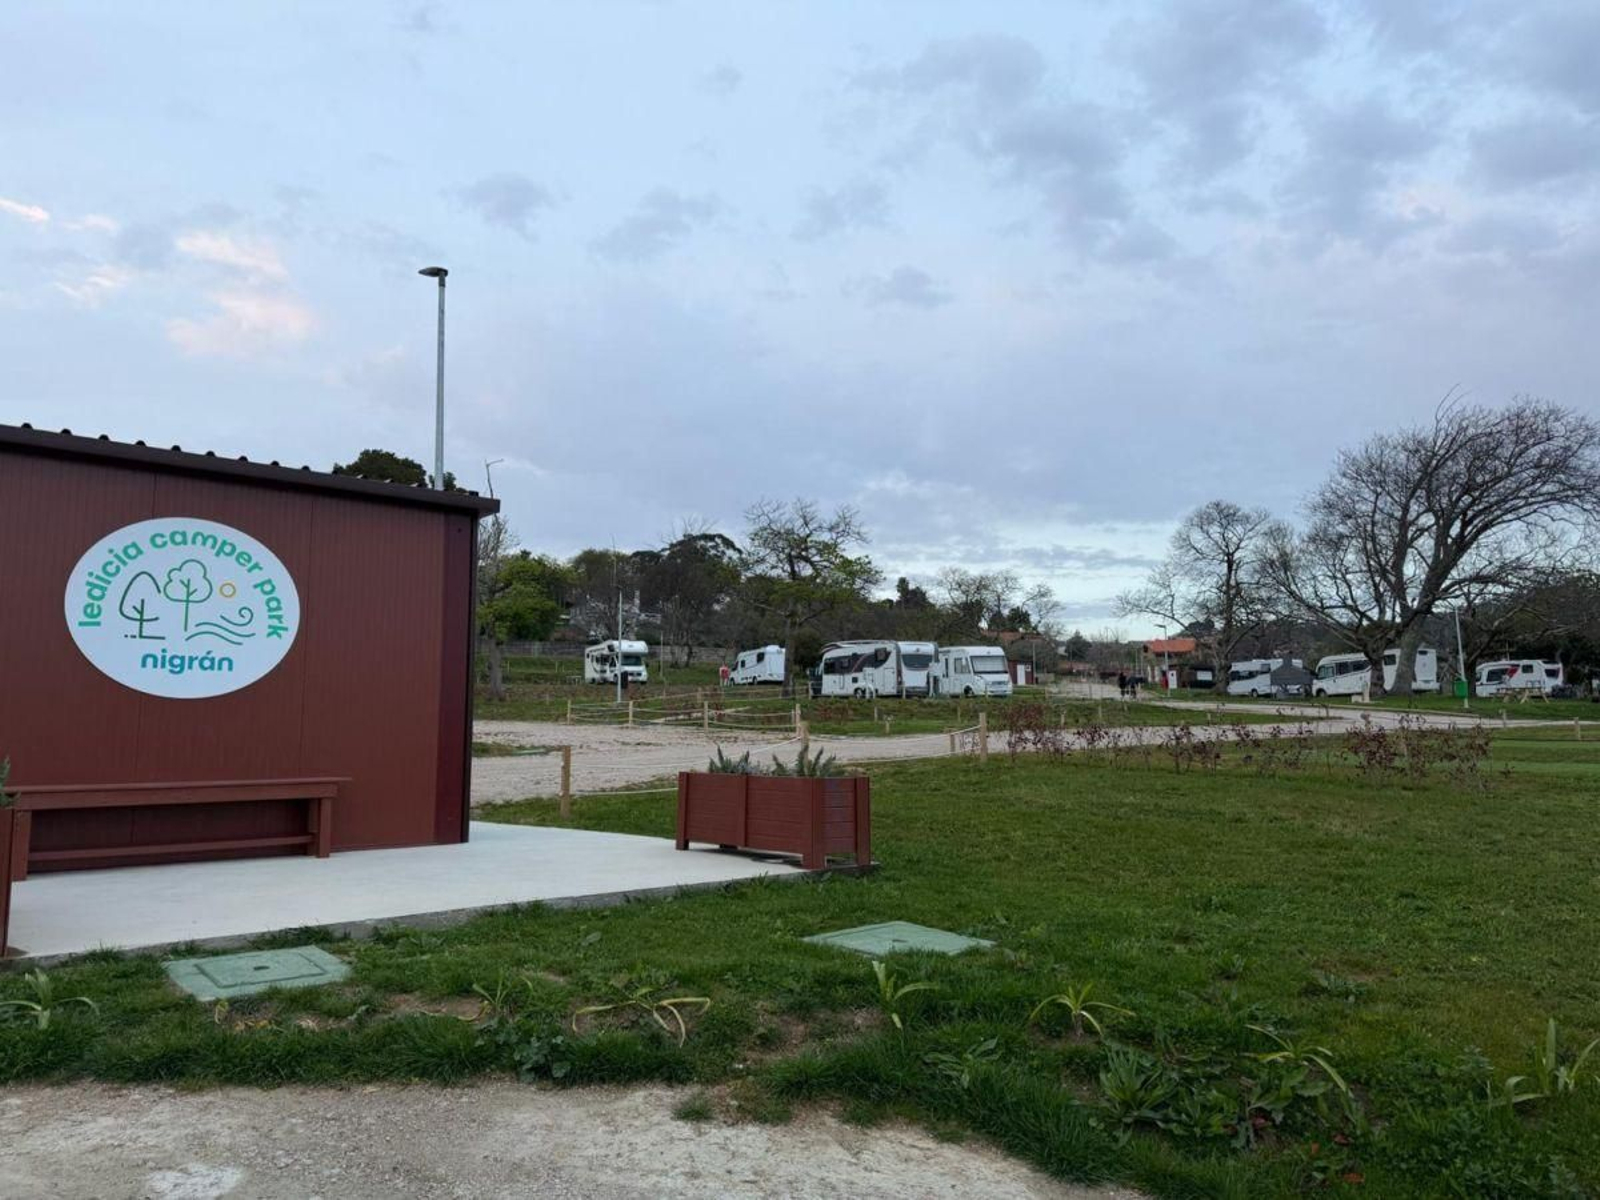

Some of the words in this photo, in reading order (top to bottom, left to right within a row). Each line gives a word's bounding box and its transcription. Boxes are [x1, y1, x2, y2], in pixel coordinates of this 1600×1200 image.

[78, 541, 144, 627] ledicia
[149, 530, 263, 574] camper
[252, 578, 289, 640] park
[140, 649, 234, 675] nigrán
